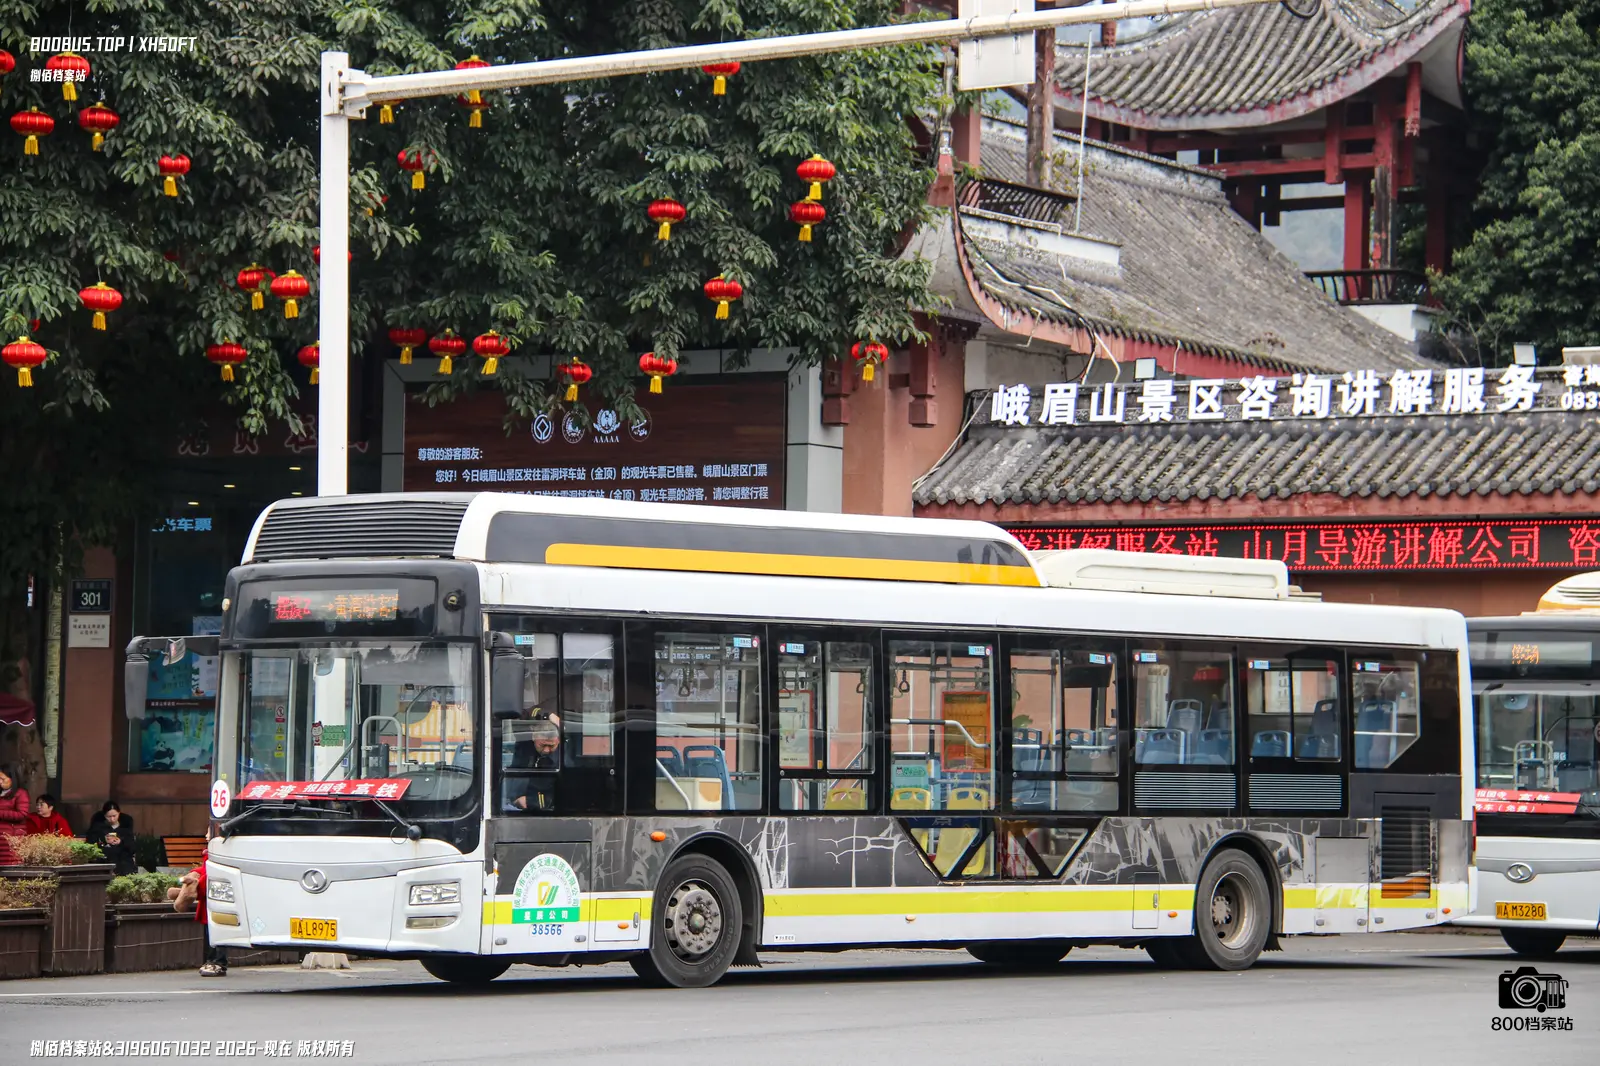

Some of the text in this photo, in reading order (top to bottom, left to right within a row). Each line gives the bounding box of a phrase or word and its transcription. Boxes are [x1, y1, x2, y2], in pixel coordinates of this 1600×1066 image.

[990, 364, 1542, 425] 峨眉山景区咨询讲解服务
[1561, 391, 1600, 410] 083
[418, 447, 483, 461] 尊敬的游客朋友：
[151, 516, 212, 532] 光车票
[1243, 526, 1540, 565] 山月导游讲解公司
[81, 592, 101, 606] 301
[213, 789, 226, 807] 26
[531, 923, 562, 935] 38566
